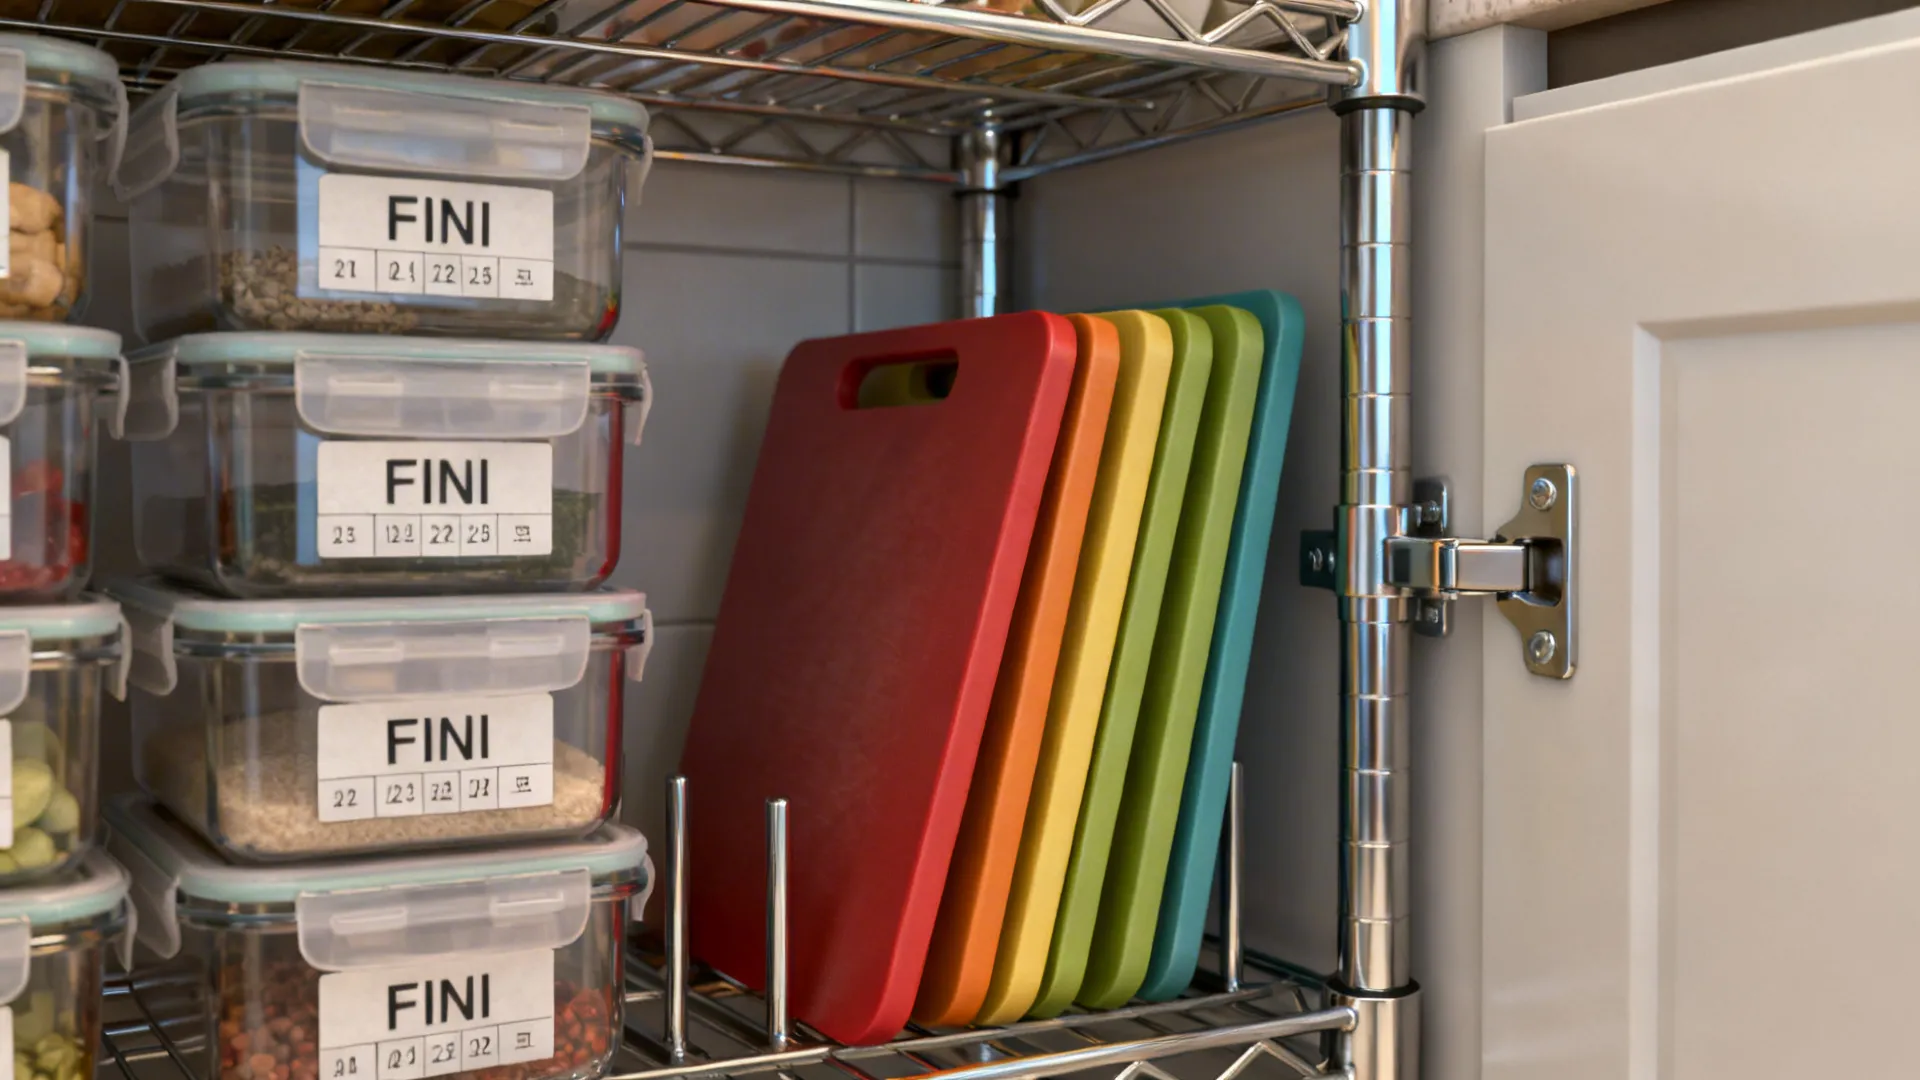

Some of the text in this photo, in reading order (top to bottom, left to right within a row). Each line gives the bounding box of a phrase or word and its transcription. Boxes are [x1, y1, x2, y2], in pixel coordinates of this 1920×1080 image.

[388, 195, 490, 247] FINI
[386, 459, 488, 505] FINI
[387, 714, 489, 765] FINI
[388, 973, 490, 1030] FINI
